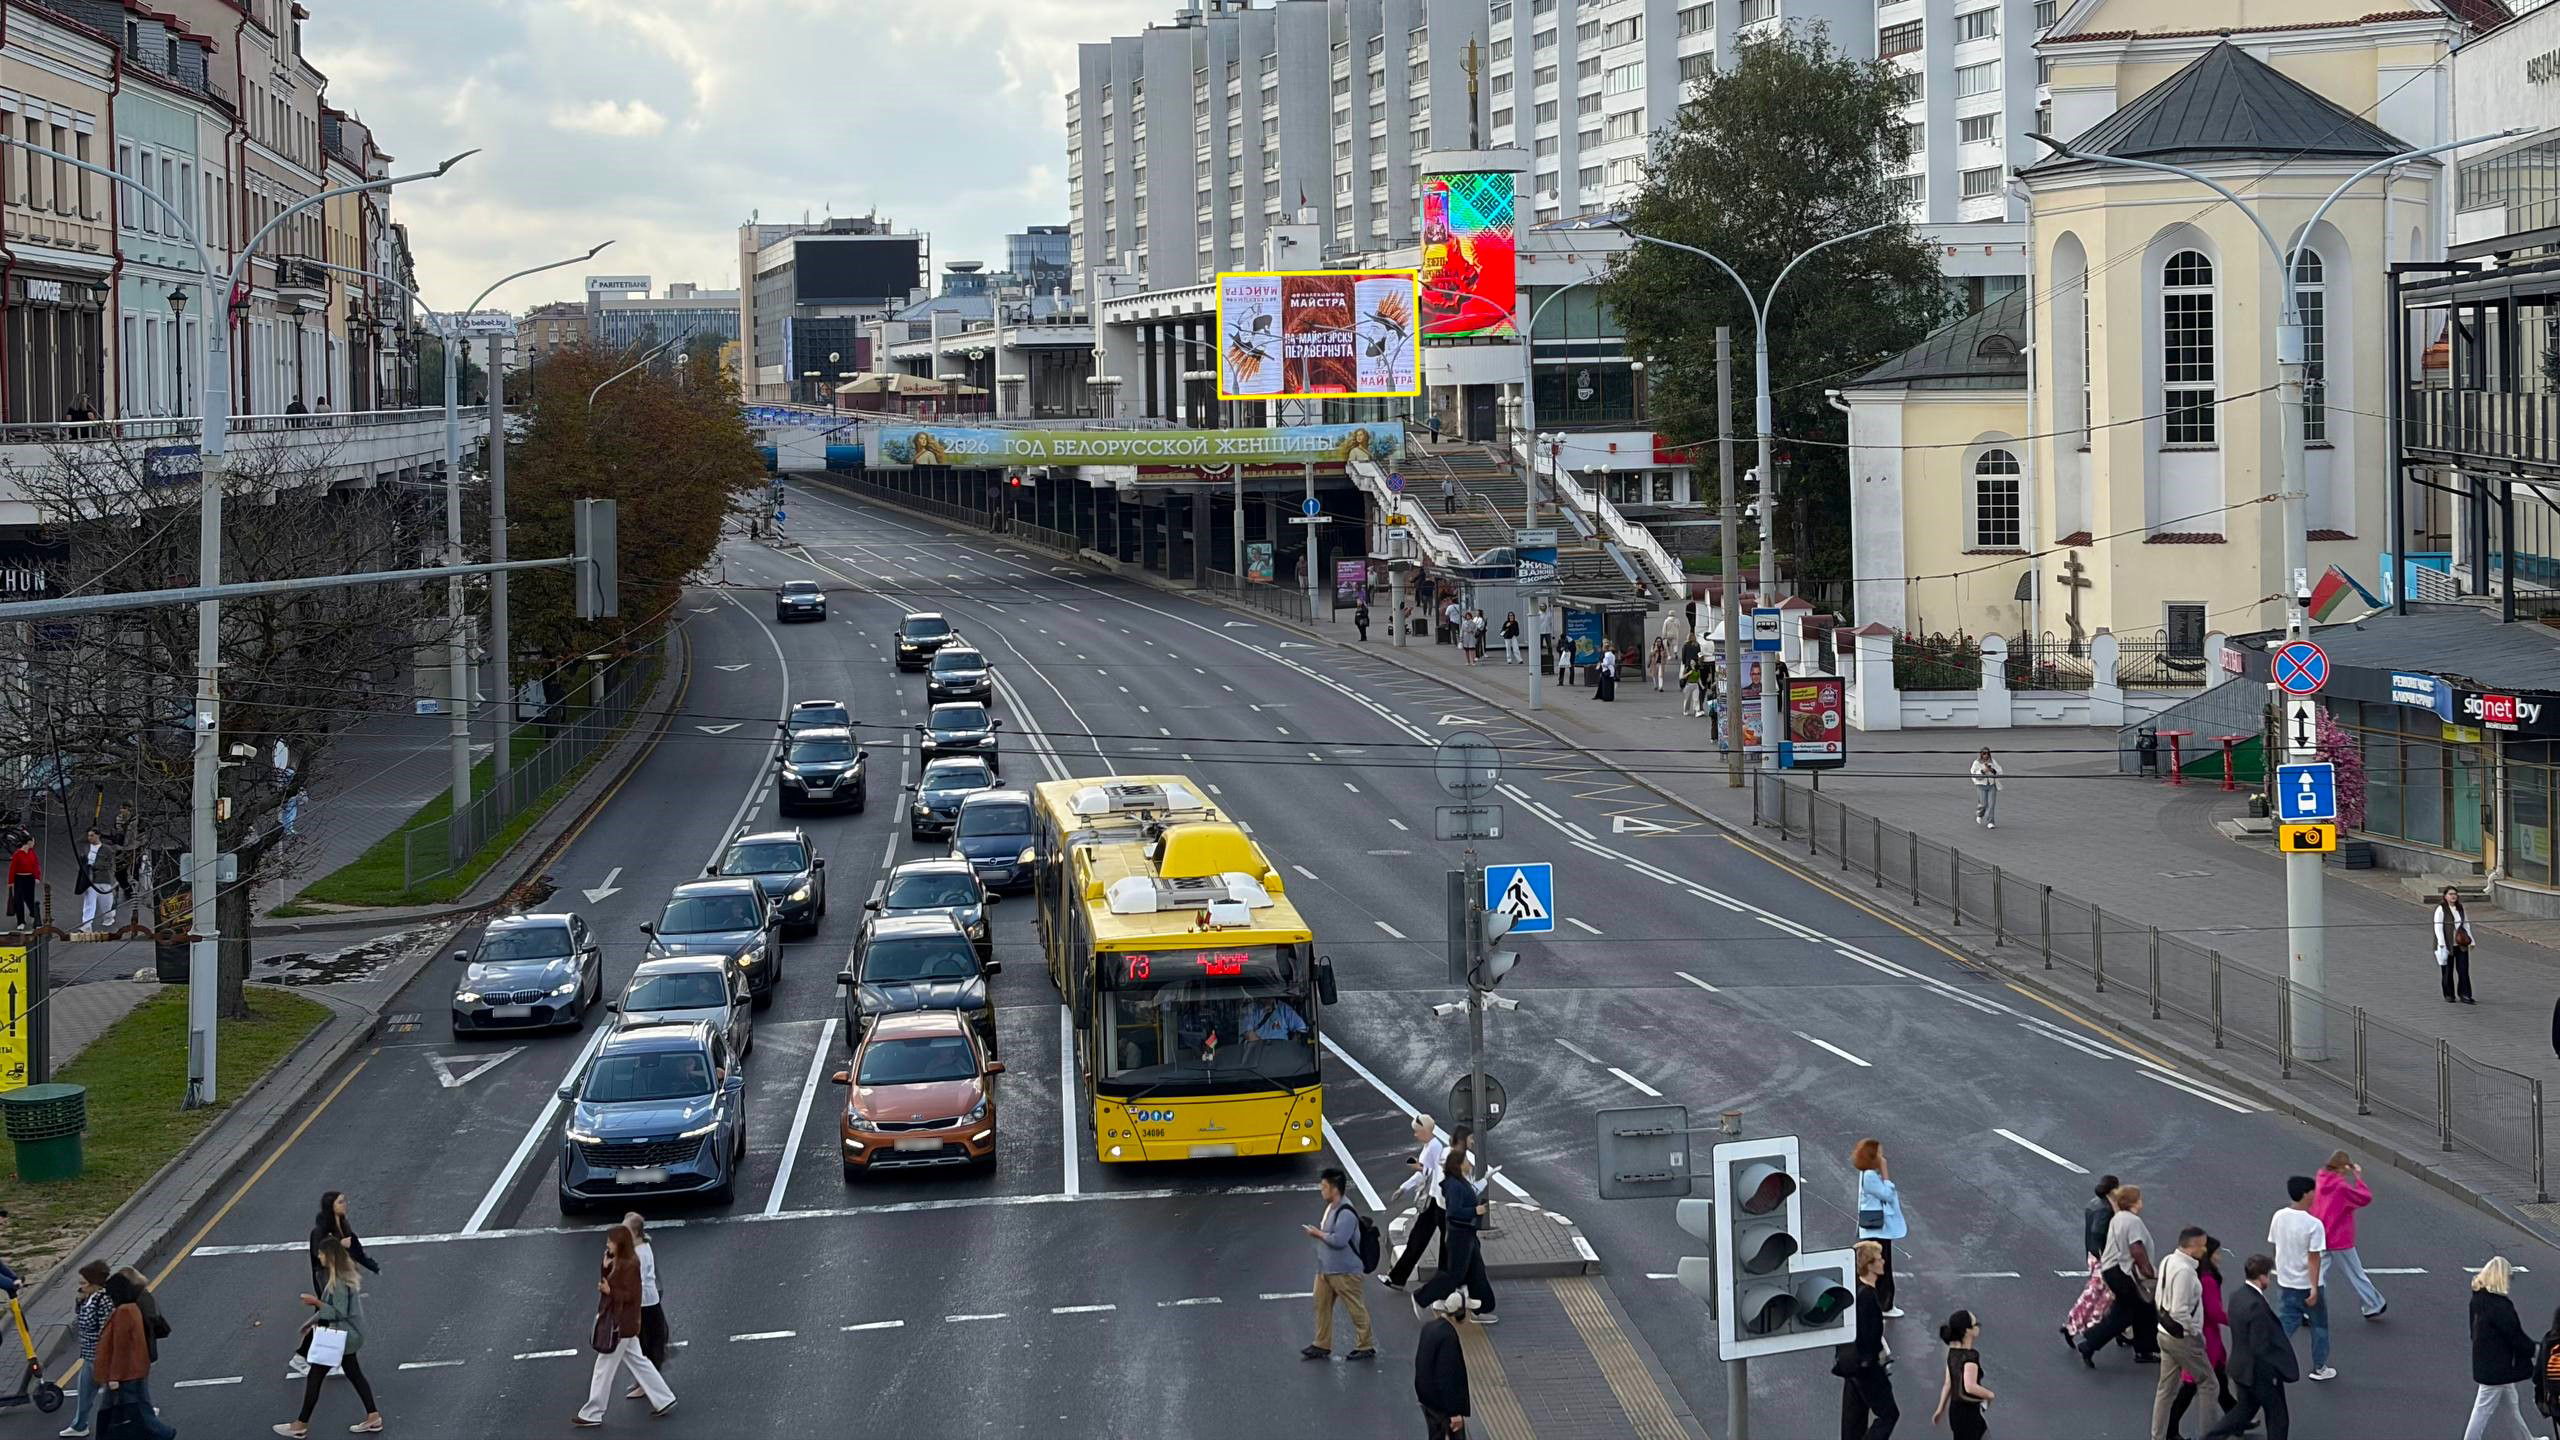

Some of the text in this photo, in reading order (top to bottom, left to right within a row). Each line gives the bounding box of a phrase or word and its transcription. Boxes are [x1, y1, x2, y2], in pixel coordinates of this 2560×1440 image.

[599, 281, 648, 289] PARITETBANK
[1290, 297, 1346, 308] МАЙСТРА
[1285, 344, 1354, 358] ПЕРАВЕРНУТА
[944, 435, 1335, 458] 2026 ГОД БЕЛОРУССКОЙ ЖЕНЩИНЫ
[1125, 954, 1150, 981] 73
